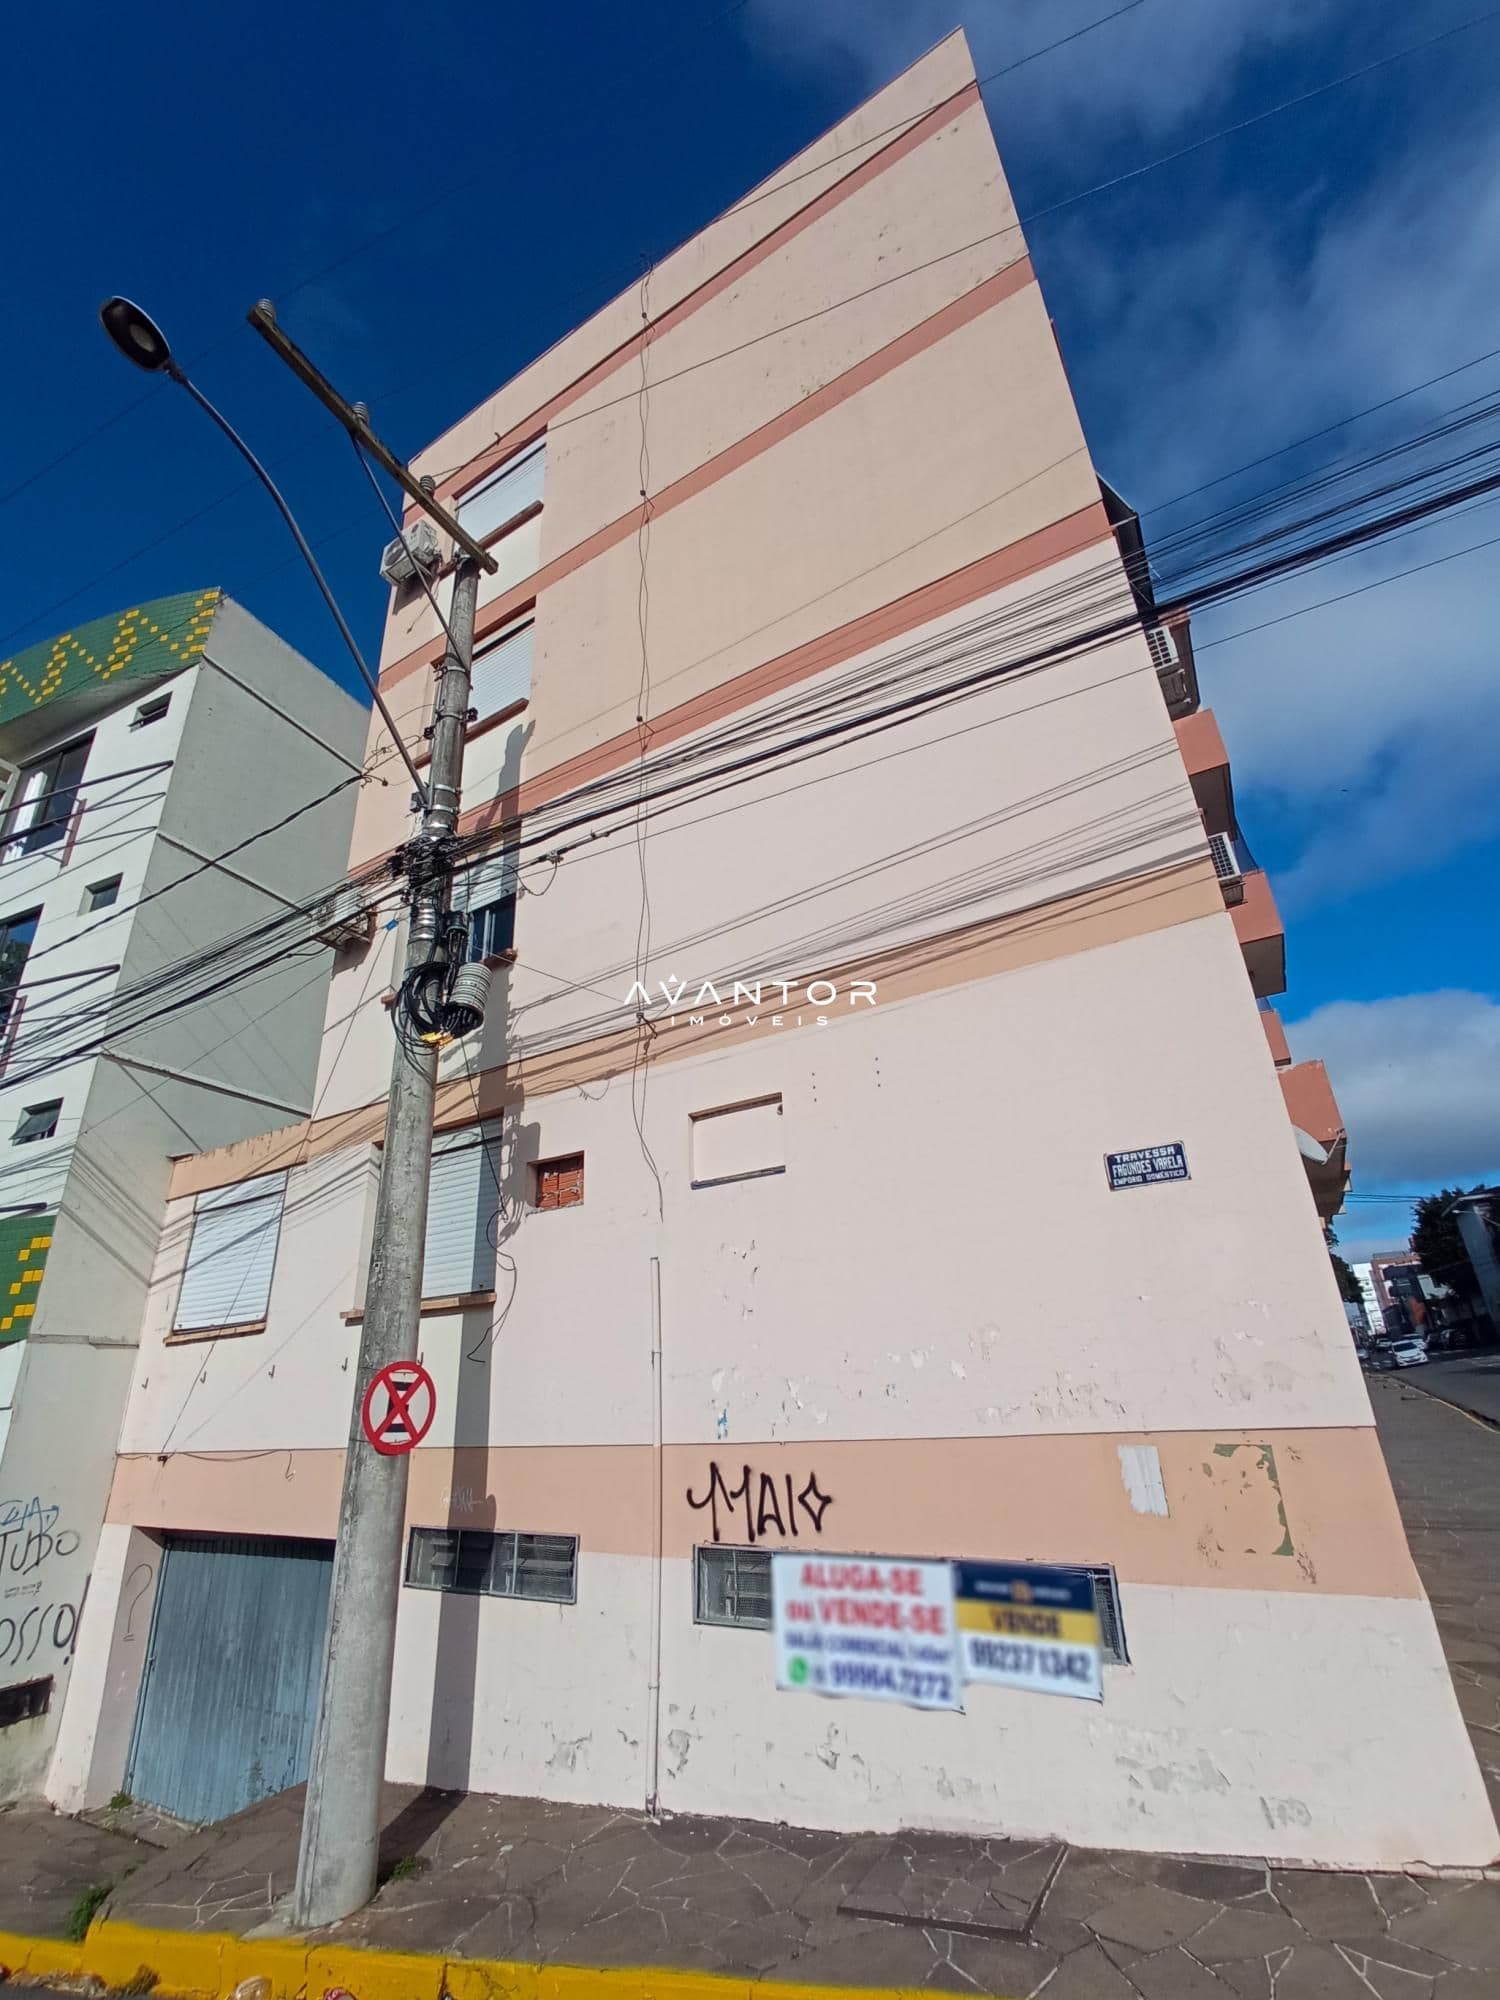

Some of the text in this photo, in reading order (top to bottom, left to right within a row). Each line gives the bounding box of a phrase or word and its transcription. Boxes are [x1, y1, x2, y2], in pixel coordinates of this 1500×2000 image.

[1111, 1155, 1184, 1178] FAGUNDES VARELA
[1114, 1146, 1175, 1163] TRAVESSA
[801, 1563, 923, 1596] ALUGA-SE
[817, 1597, 945, 1635] VENDE-SE
[988, 1604, 1062, 1640] VENDE
